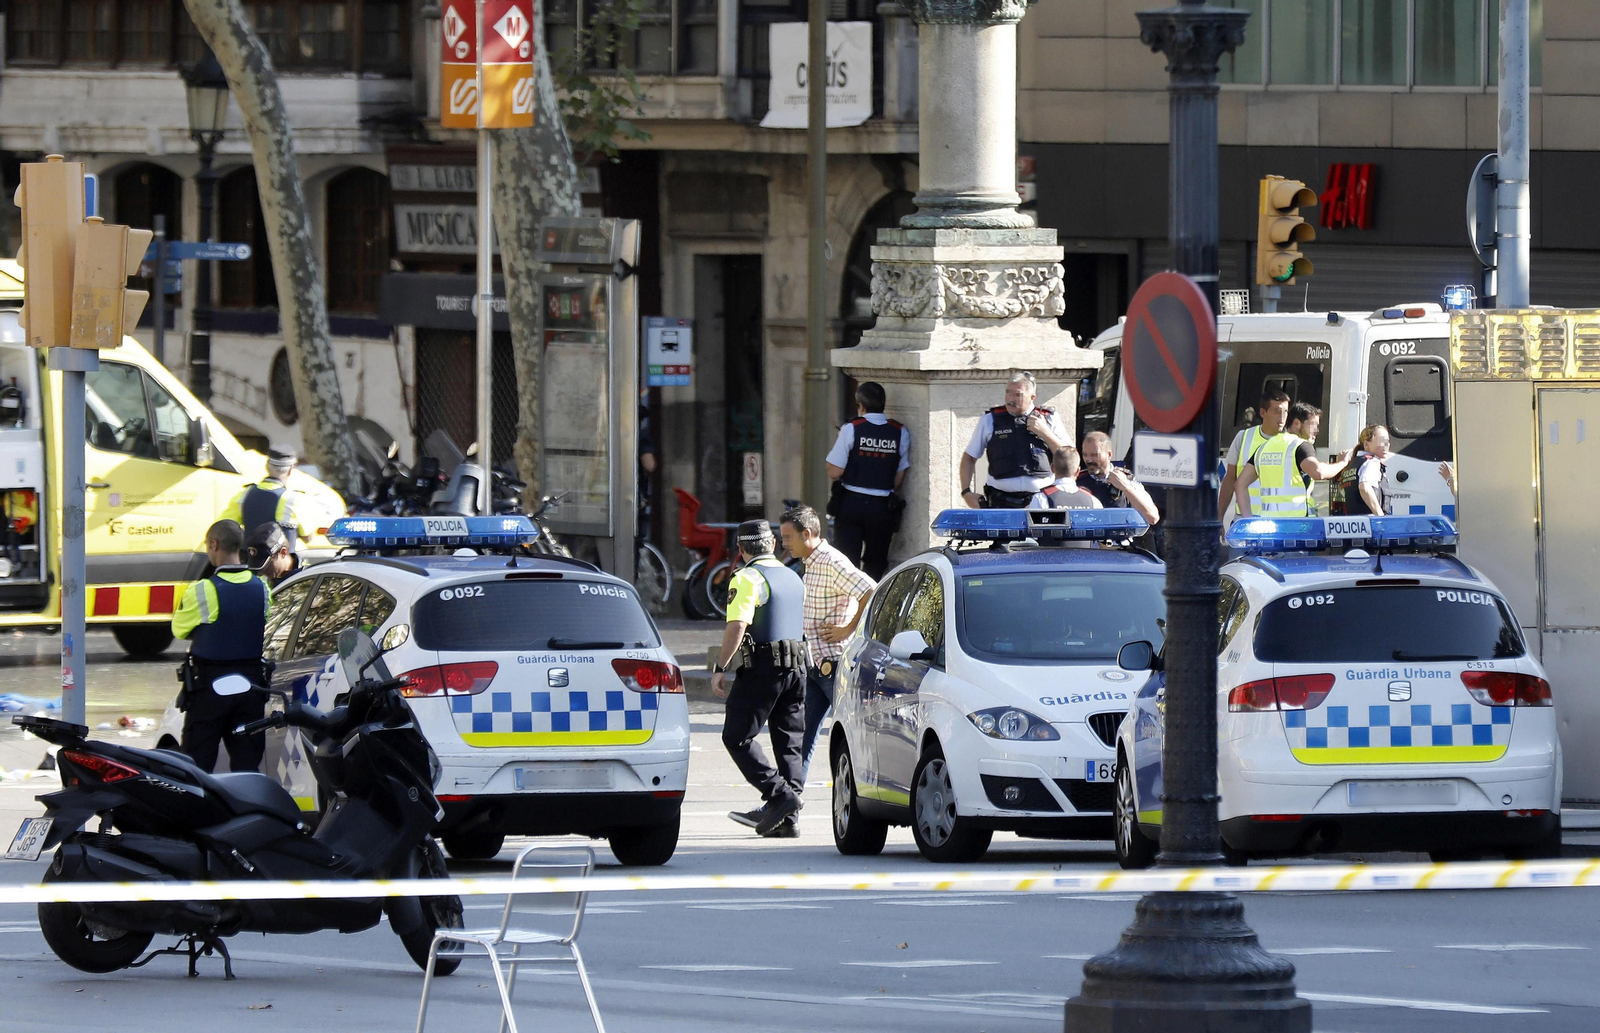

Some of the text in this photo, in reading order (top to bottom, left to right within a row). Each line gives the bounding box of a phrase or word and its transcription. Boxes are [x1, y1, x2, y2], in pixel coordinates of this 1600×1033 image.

[446, 17, 456, 36] M
[506, 17, 520, 36] M
[1306, 346, 1330, 360] Policia
[1391, 341, 1416, 355] 092
[860, 437, 897, 449] POLICIA
[1137, 465, 1160, 477] Motos
[128, 526, 174, 536] CatSalut
[427, 519, 464, 532] POLICIA
[1328, 521, 1367, 534] POLICIA
[455, 585, 485, 599] 092
[579, 584, 628, 599] Policia
[1436, 590, 1495, 607] POLICIA
[1305, 594, 1335, 606] 092
[517, 654, 595, 665] Guàrdia Urbana
[626, 651, 649, 660] C-700
[1345, 668, 1451, 681] Guàrdia Urbana
[1039, 691, 1127, 706] Guàrdia
[25, 819, 50, 837] 1679
[17, 834, 37, 852] JGP
